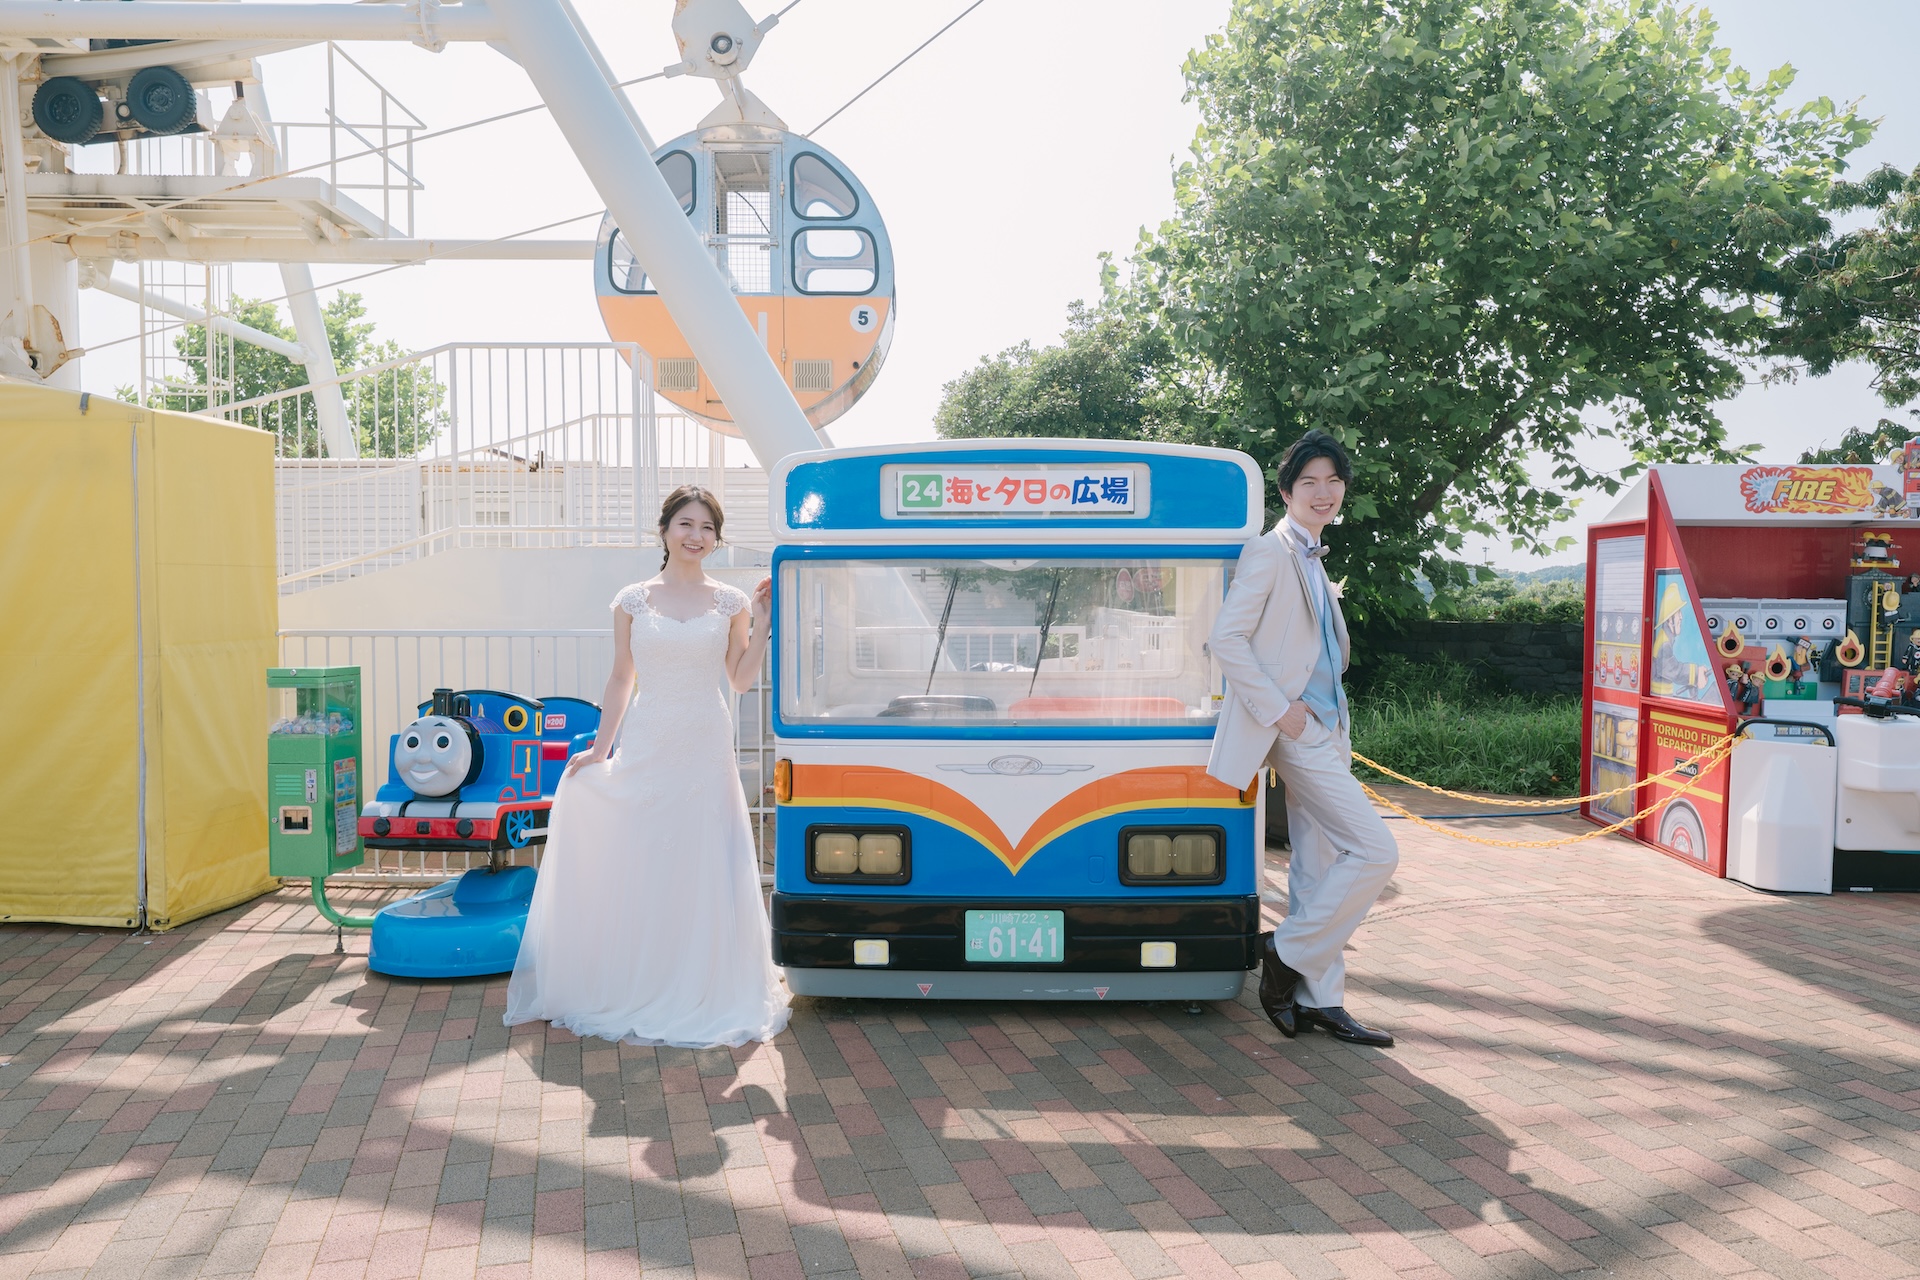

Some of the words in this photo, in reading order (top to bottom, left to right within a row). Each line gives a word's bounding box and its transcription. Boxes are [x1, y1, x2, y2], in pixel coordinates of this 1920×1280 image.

[858, 311, 869, 326] 5
[906, 480, 941, 501] 24
[945, 476, 1129, 506] 海と夕日の広場
[1772, 480, 1837, 501] FIRE
[1653, 722, 1698, 743] TORNADO
[524, 747, 531, 773] 1
[970, 938, 984, 950] ほ
